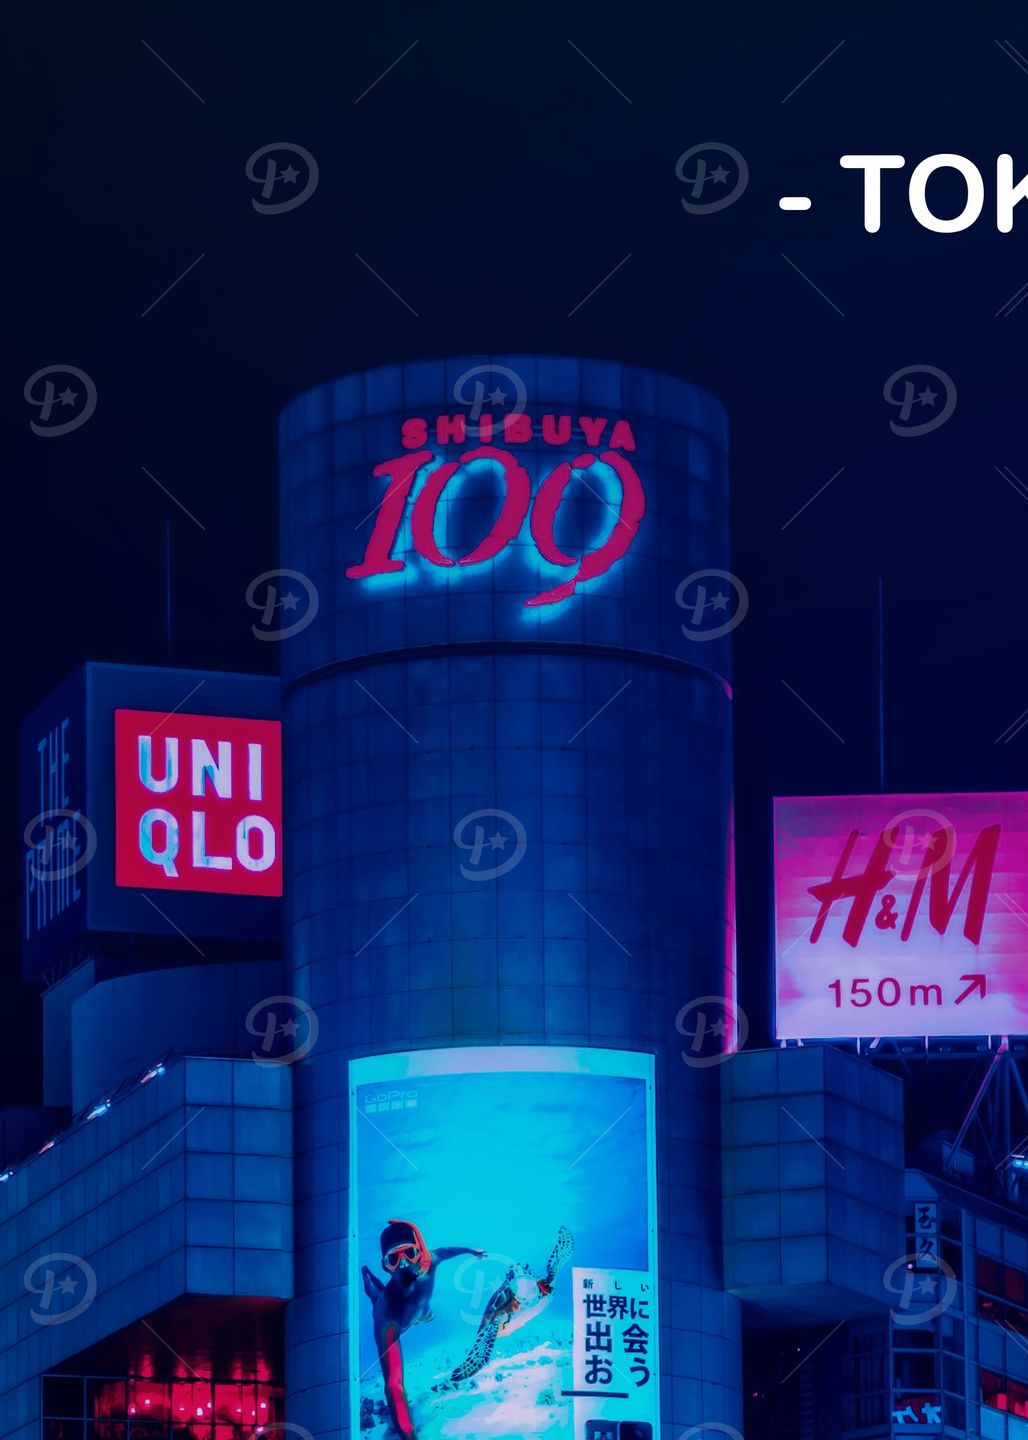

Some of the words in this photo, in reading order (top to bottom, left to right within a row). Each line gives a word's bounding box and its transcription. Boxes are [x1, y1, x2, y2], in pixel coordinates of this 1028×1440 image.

[401, 413, 637, 451] SHIBUYA
[345, 446, 646, 608] 109
[37, 717, 70, 828] THE
[138, 735, 262, 801] UNI
[26, 809, 81, 940] PRIME
[138, 810, 277, 878] QLO
[807, 823, 1002, 949] H&M
[366, 1090, 418, 1103] GoPro
[583, 1278, 650, 1291] 新しい
[583, 1294, 650, 1320] 世界に
